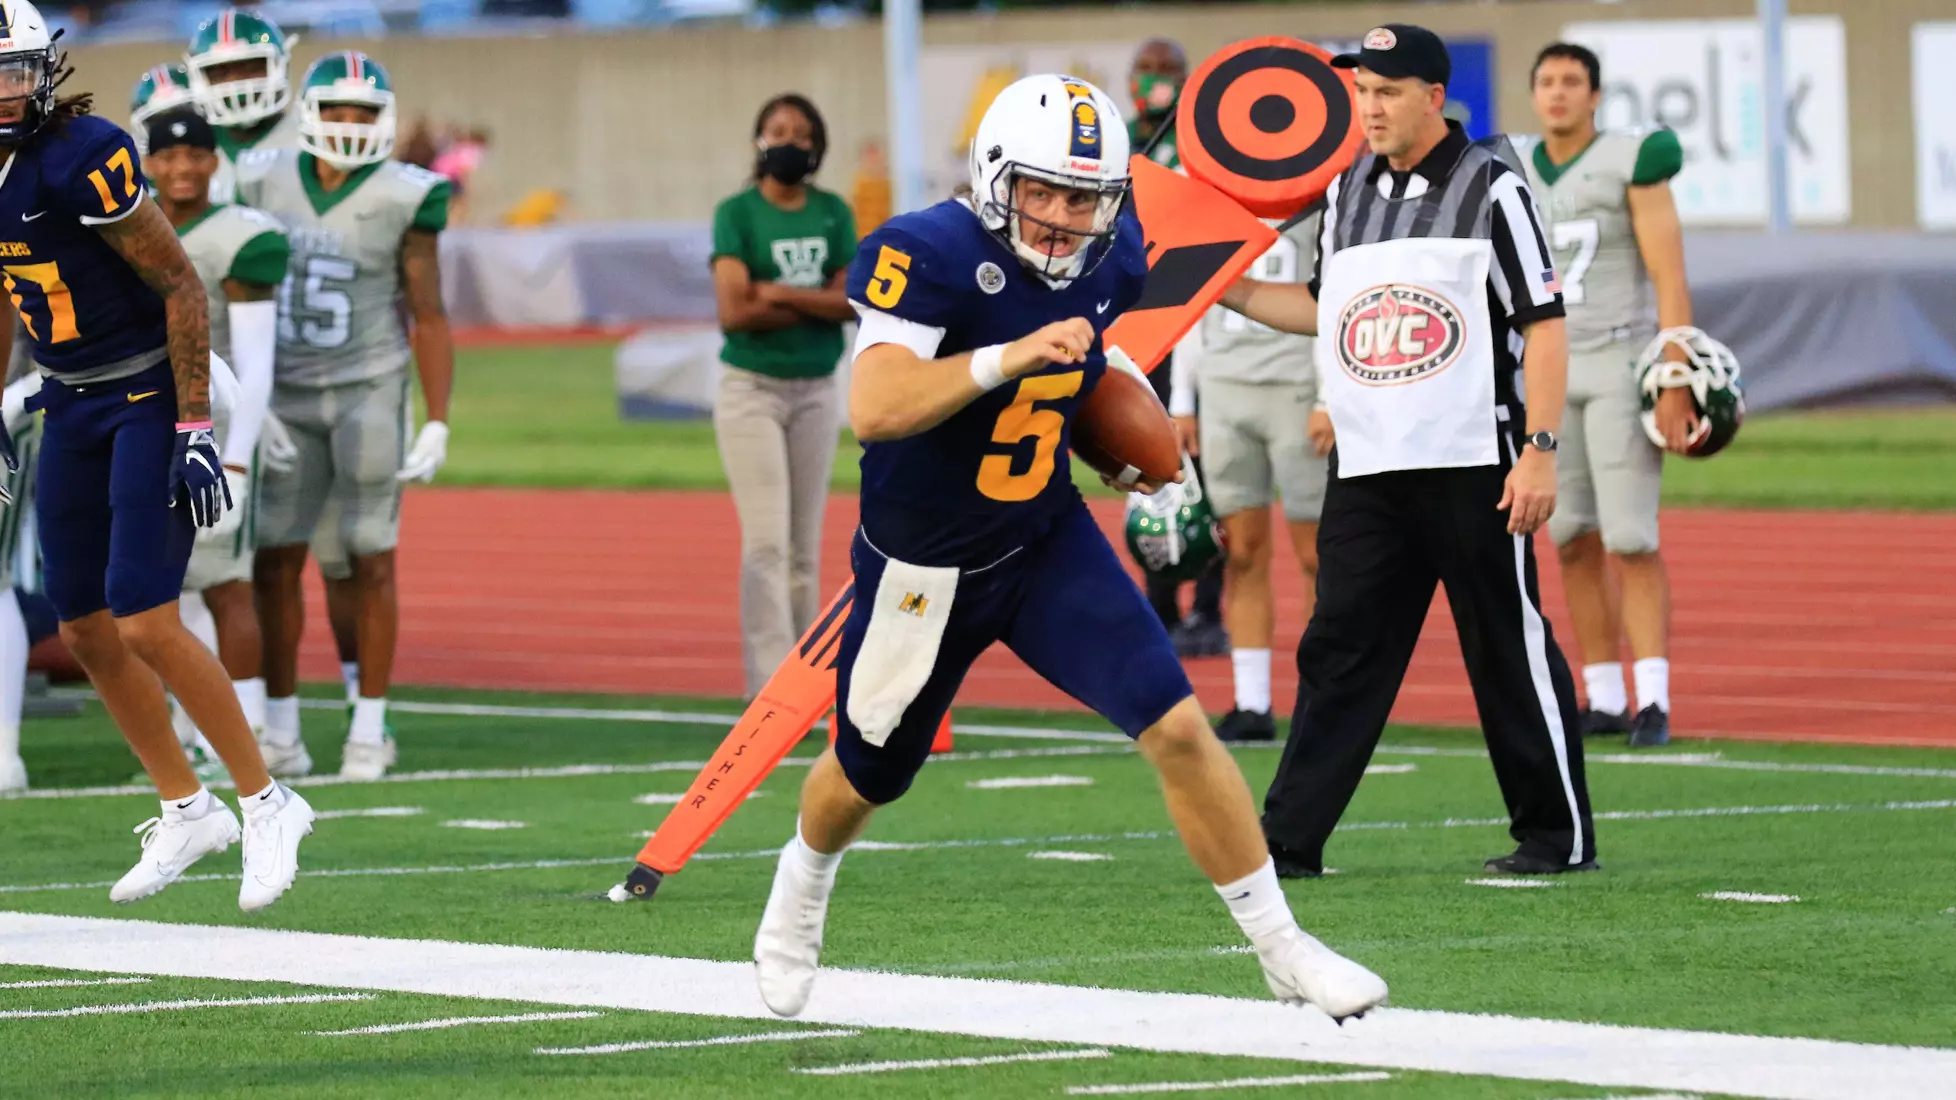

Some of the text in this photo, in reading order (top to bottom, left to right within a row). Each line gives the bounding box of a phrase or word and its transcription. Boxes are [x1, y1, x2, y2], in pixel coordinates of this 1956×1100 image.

[87, 146, 138, 214] 17
[865, 244, 912, 309] 5
[1353, 313, 1429, 361] OVC
[975, 369, 1085, 503] 5
[691, 710, 776, 809] FISHER
